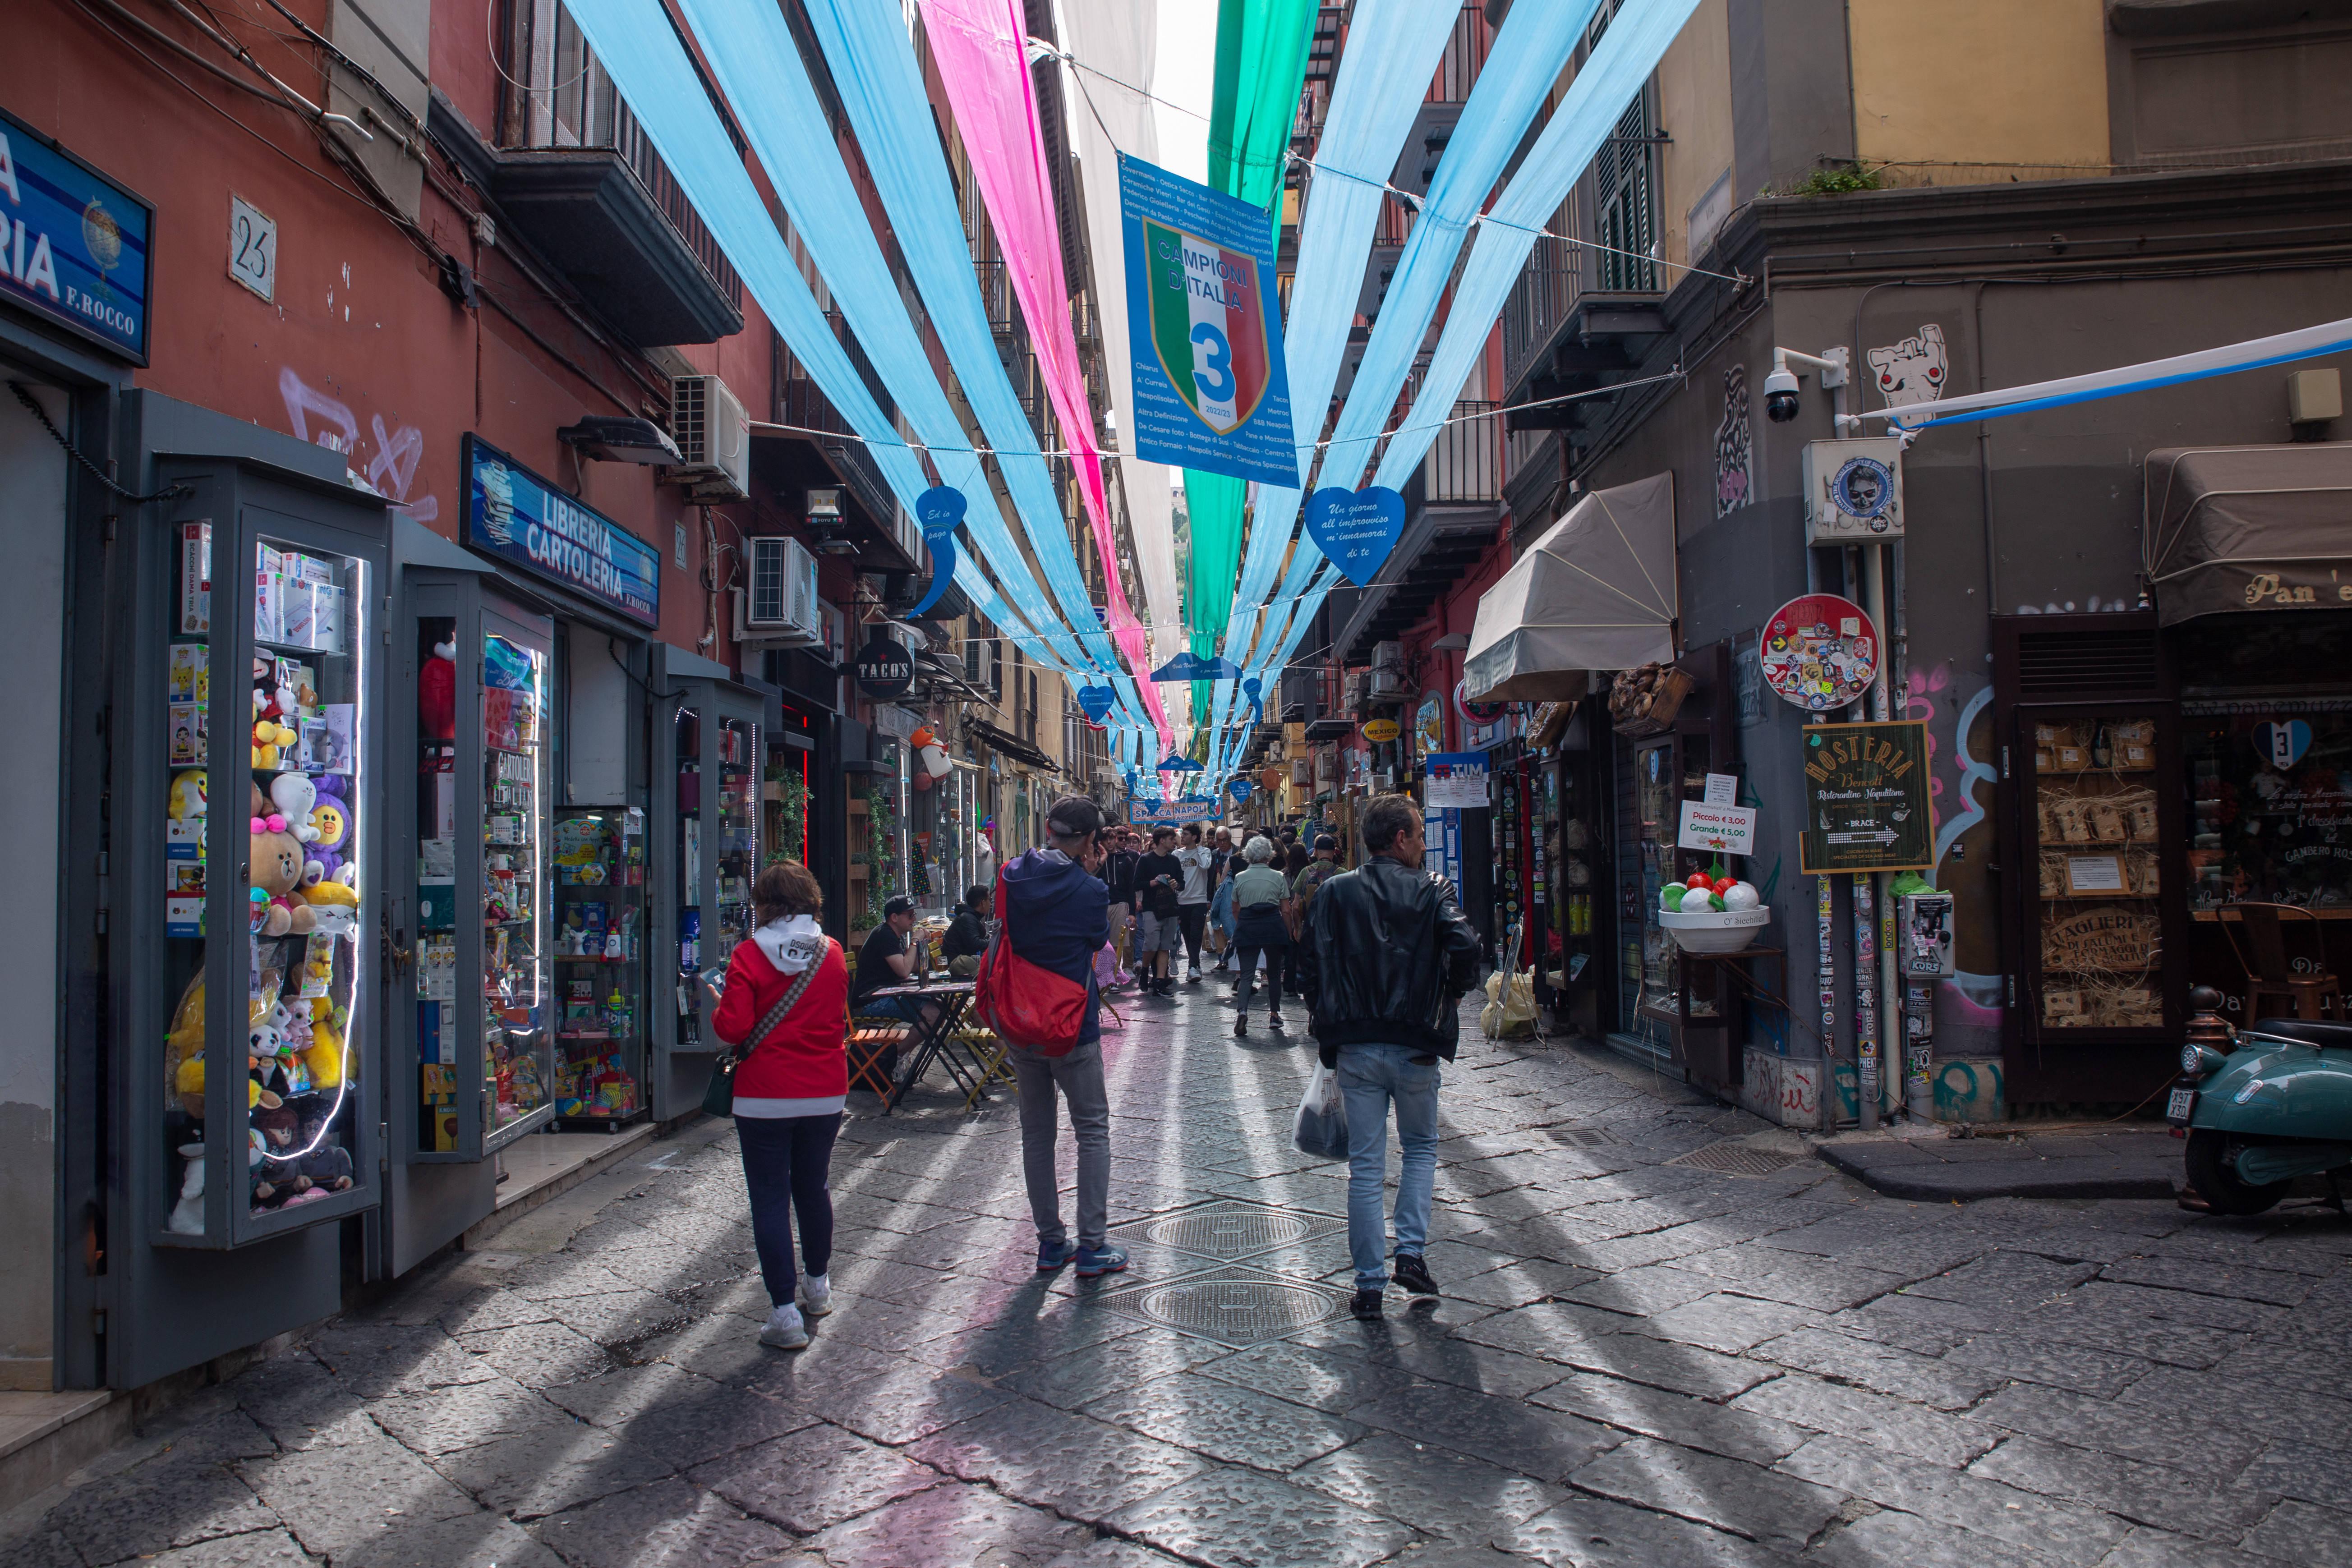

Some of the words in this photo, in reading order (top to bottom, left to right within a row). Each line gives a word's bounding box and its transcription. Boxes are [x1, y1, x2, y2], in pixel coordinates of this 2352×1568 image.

[1121, 164, 1155, 182] Covermania
[1160, 179, 1178, 190] Ottica
[1179, 186, 1194, 197] Sacco
[1210, 198, 1227, 210] Mexico
[1232, 207, 1251, 220] Pizzeria
[1252, 215, 1268, 225] Costa
[1123, 175, 1154, 192] Ceramiche
[1155, 187, 1171, 198] Vietri
[1177, 195, 1186, 203] Bar
[1215, 211, 1236, 225] Espresso
[1238, 221, 1270, 235] Napoletano
[1123, 186, 1147, 201] Federico
[1150, 197, 1179, 212] Gioielleria
[1184, 209, 1209, 224] Pescheria
[1211, 220, 1226, 231] Acqua
[1227, 226, 1240, 237] Pazza
[1245, 233, 1271, 244] Indissima
[1125, 211, 1140, 221] Neox
[1124, 199, 1149, 213] Detersivi
[1158, 212, 1173, 222] Paolo
[1178, 219, 1203, 235] Cartoleria
[1205, 230, 1219, 240] Rocco
[1224, 237, 1248, 251] Gioielleria
[1250, 246, 1272, 256] Varriale
[1158, 239, 1247, 288] CAMPIONI
[1169, 270, 1243, 313] D’ITALIA
[66, 285, 134, 335] F.ROCCO
[1136, 363, 1158, 373] Chiarus
[1190, 322, 1236, 402] 3
[1273, 395, 1289, 404] Tacos
[1138, 408, 1153, 417] Altra
[1154, 411, 1188, 423] Definizione
[1206, 406, 1230, 418] 2022/23
[1266, 421, 1291, 430] Neapolis
[1148, 424, 1170, 434] Cesare
[1172, 428, 1184, 437] foto
[1190, 432, 1211, 443] Bottega
[1219, 437, 1229, 446] Susi
[1265, 449, 1284, 457] Centro
[1246, 431, 1257, 440] Pane
[1139, 436, 1158, 446] Antico
[1159, 440, 1183, 450] Fornaio
[1188, 444, 1211, 455] Neapolis
[1213, 450, 1232, 460] Service
[1237, 455, 1261, 466] Cartoleria
[1263, 461, 1297, 473] Spaccanapoli
[928, 510, 940, 520] Ed
[1328, 504, 1345, 514] Un
[1349, 504, 1377, 516] giorno
[544, 490, 612, 561] LIBRERIA
[1321, 519, 1335, 529] all
[1339, 516, 1389, 529] improvviso
[927, 531, 946, 541] pago
[677, 531, 686, 563] 26
[1347, 548, 1357, 558] di
[1361, 548, 1370, 556] te
[308, 557, 326, 569] DOMINO
[527, 523, 622, 600] CARTOLERIA
[291, 578, 332, 596] BOWING
[2245, 573, 2316, 605] Pan
[626, 593, 650, 614] F.ROCCO
[859, 662, 908, 678] TACO'S
[2276, 732, 2288, 756] 3
[1805, 736, 1913, 783] HOSTERIA
[1453, 763, 1483, 777] TIM
[1817, 790, 1862, 800] Ristorantino
[1864, 788, 1905, 800] Napulitano
[1175, 805, 1206, 814] NAPOLI
[1693, 812, 1719, 822] Piccolo
[1728, 817, 1745, 825] 3,00
[1690, 823, 1719, 834] Grande
[1727, 828, 1745, 837] 5,00
[2285, 846, 2330, 862] GAMBERO
[1884, 921, 1893, 949] london
[2053, 916, 2133, 943] TAGLIERI
[2067, 941, 2079, 950] DI
[2084, 935, 2126, 948] SALUMI
[2132, 933, 2138, 942] E
[2074, 944, 2136, 958] FORMAGGI
